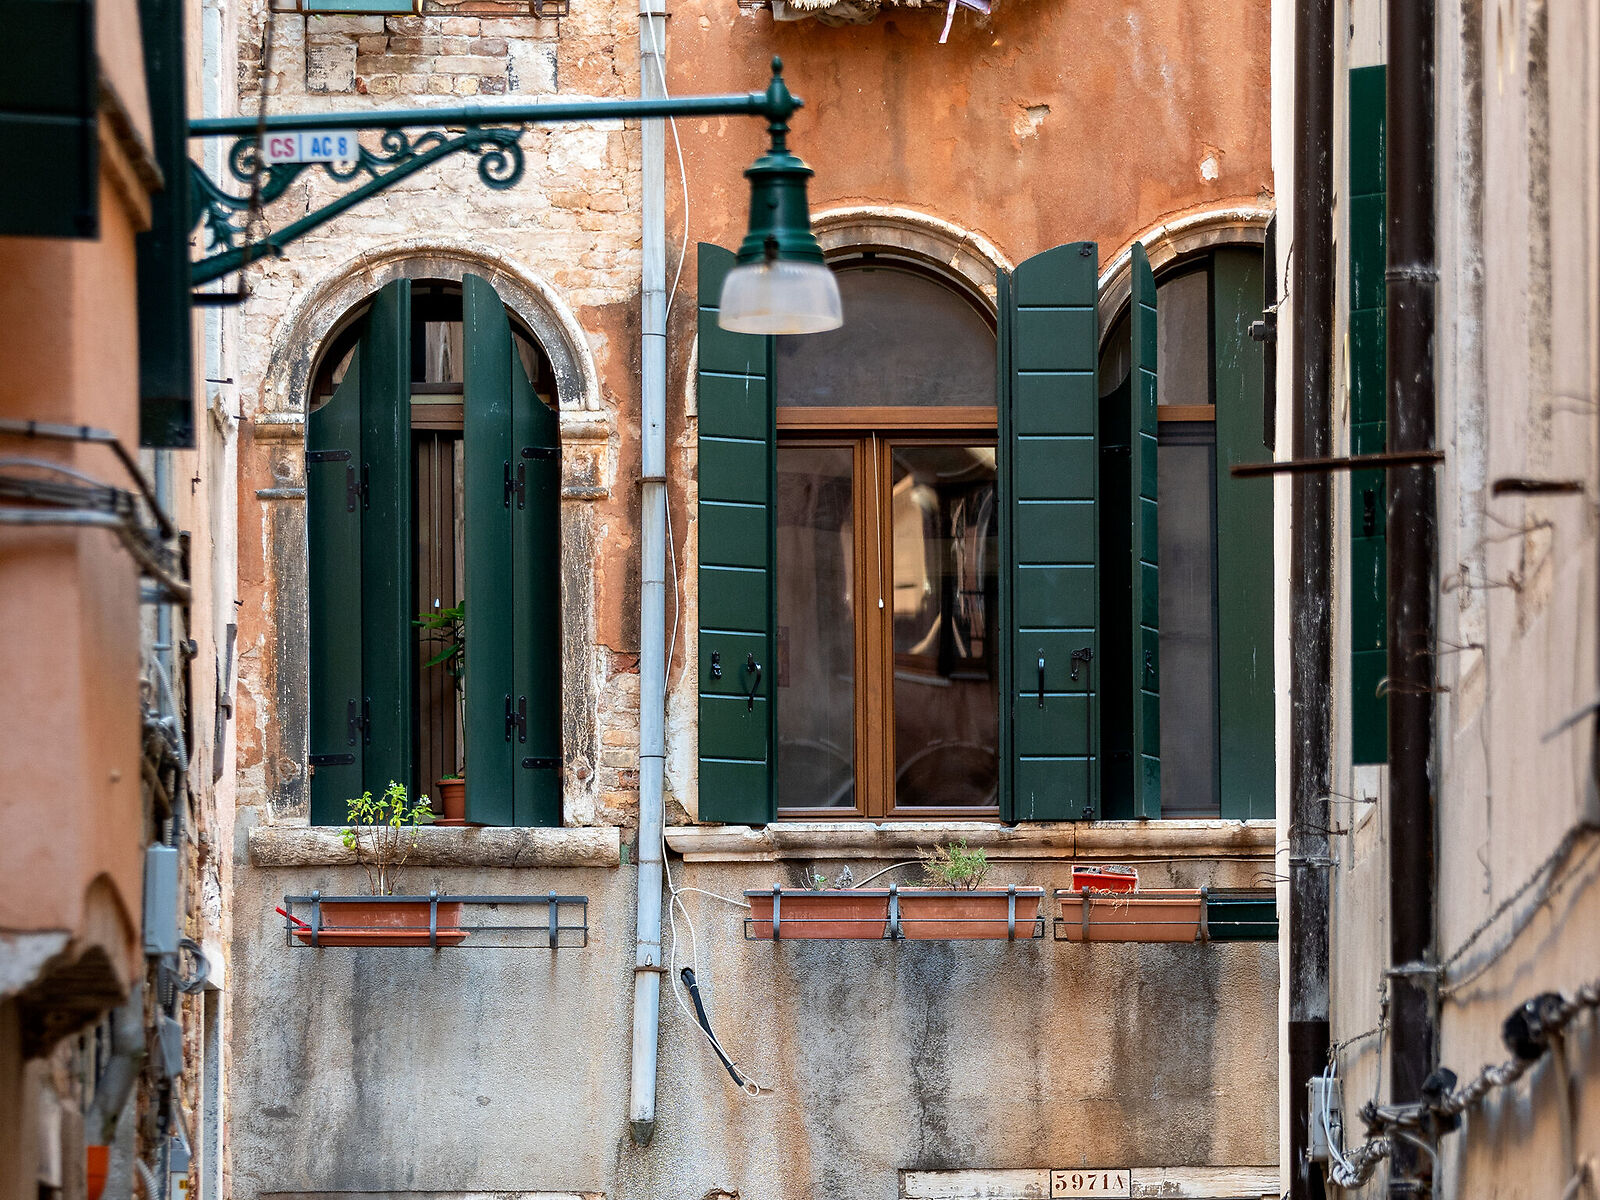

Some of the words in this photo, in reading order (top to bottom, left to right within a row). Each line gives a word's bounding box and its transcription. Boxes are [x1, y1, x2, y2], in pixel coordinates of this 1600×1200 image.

[270, 138, 295, 158] CS
[311, 137, 332, 156] AC
[338, 137, 347, 155] 8
[1055, 1173, 1124, 1190] 5971A
